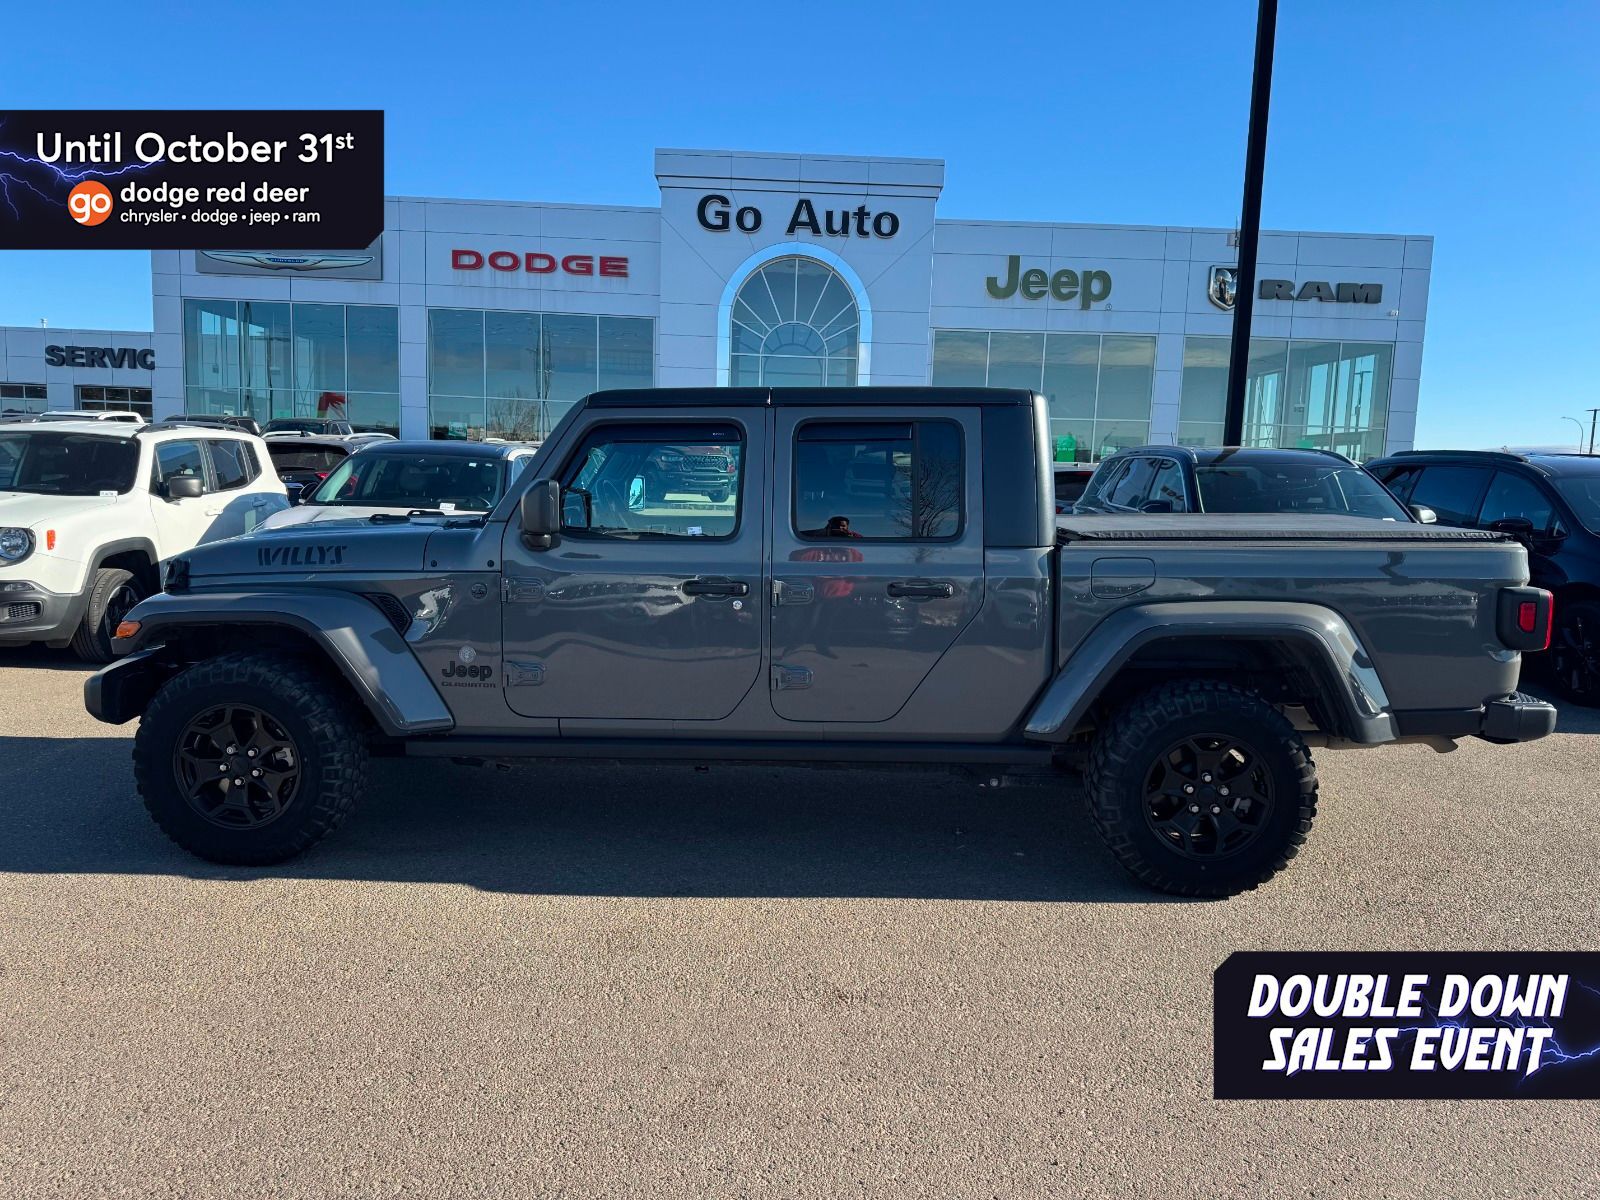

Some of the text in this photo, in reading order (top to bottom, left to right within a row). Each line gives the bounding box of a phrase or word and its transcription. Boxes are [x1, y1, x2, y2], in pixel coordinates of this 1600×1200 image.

[696, 193, 901, 239] Go Auto
[451, 249, 629, 278] DODGE
[985, 254, 1112, 311] Jeep
[1259, 278, 1383, 305] RAM
[45, 344, 155, 371] SERVIC
[257, 544, 348, 567] WILLYS
[441, 660, 493, 682] Jeep
